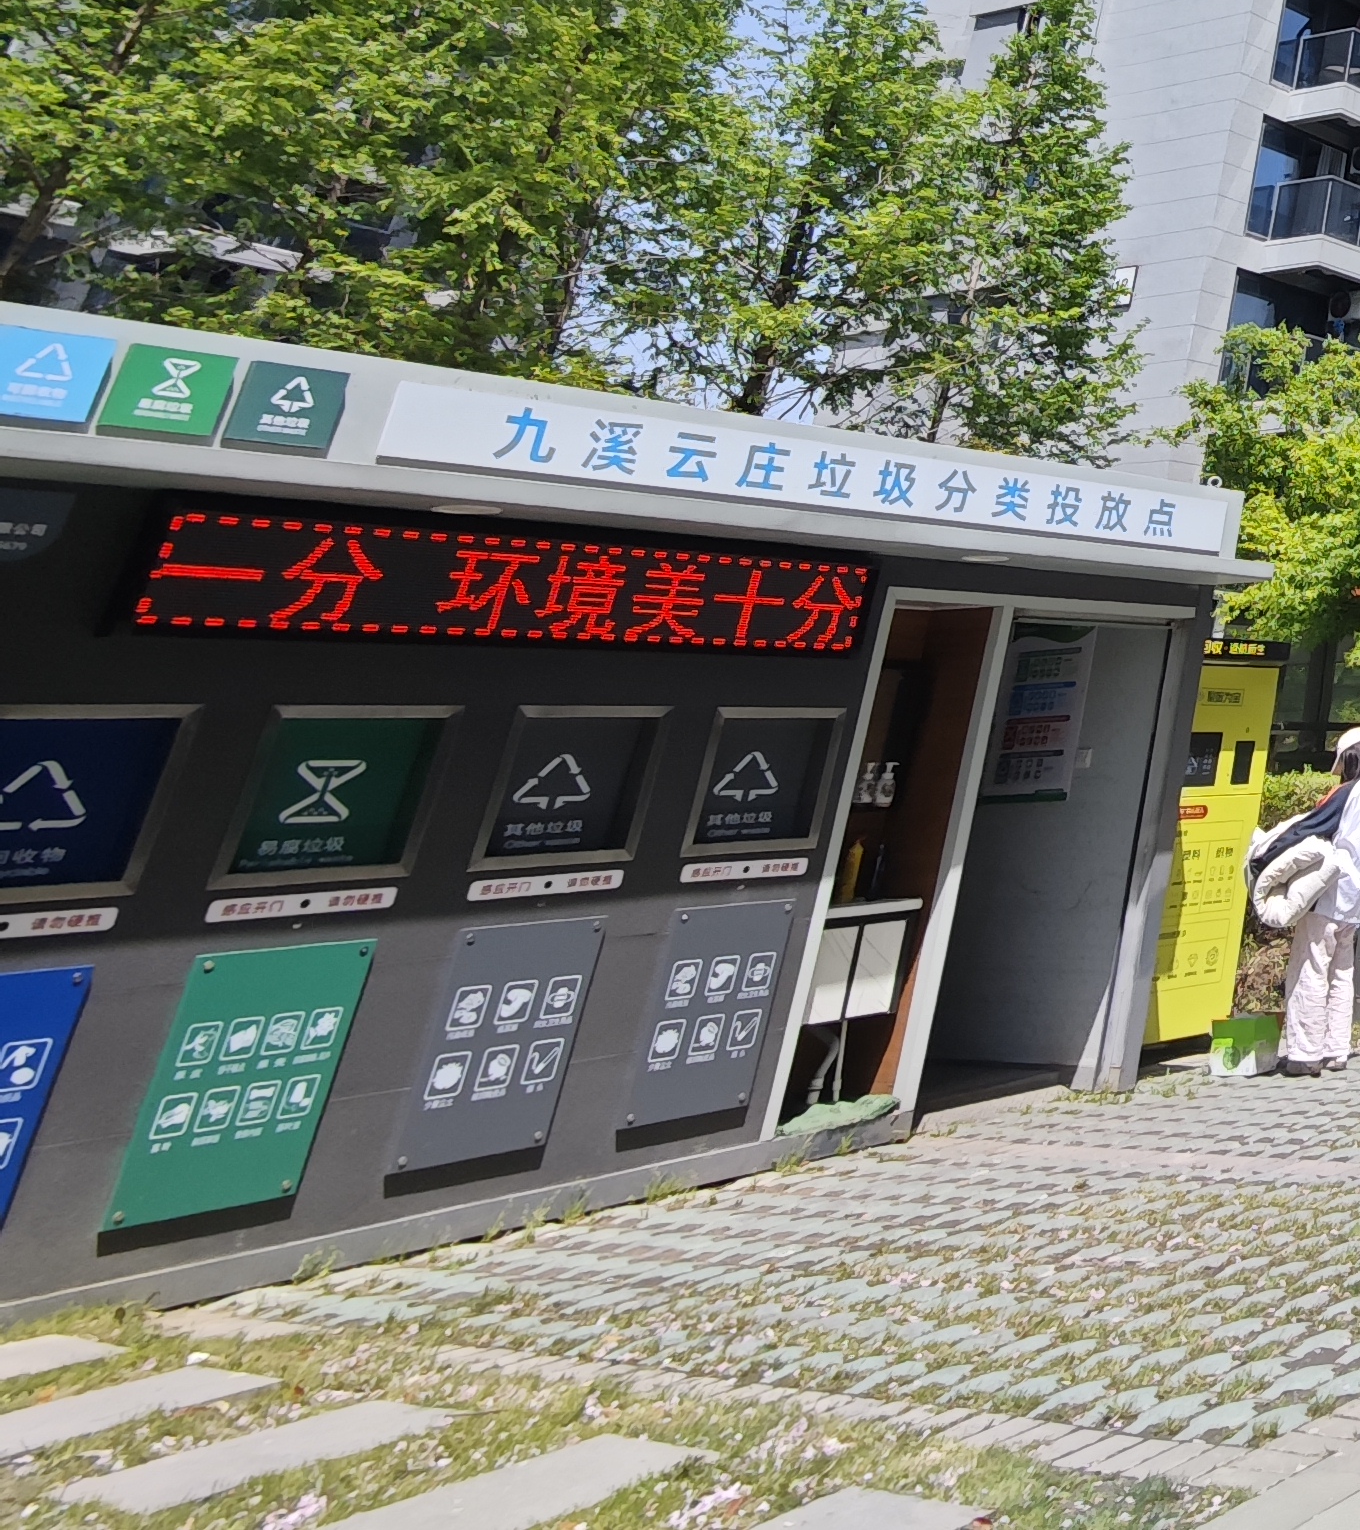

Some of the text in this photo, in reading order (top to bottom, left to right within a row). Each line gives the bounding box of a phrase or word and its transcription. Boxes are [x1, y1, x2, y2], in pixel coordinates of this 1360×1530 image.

[493, 406, 1176, 538] 九溪云庄垃圾分类投放点
[150, 538, 863, 647] 一分 环境美十分
[707, 811, 772, 826] 其他垃圾
[503, 820, 583, 837] 其他垃圾
[258, 836, 345, 857] 易腐垃圾
[221, 900, 284, 918] 感应开门
